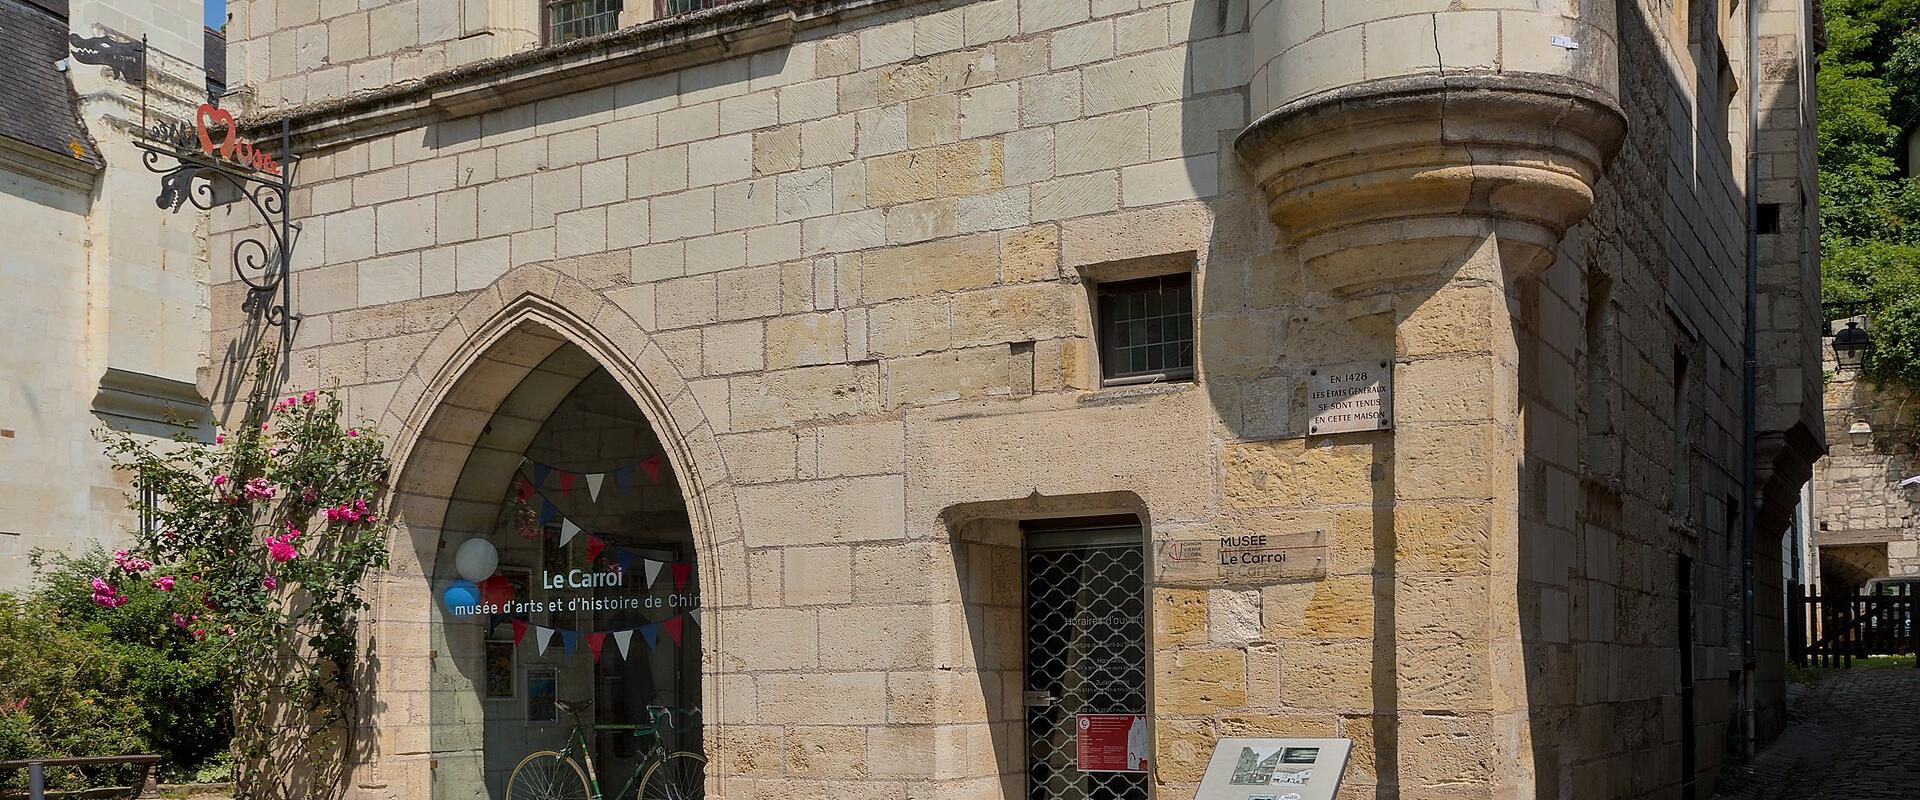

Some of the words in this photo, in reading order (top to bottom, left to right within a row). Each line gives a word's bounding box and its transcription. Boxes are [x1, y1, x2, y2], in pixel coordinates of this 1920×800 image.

[1330, 375, 1341, 383] EN
[1345, 372, 1368, 382] 1428
[1312, 391, 1325, 399] LES
[1318, 403, 1328, 411] SE
[1330, 401, 1352, 410] SONT
[1355, 399, 1381, 408] TENUS
[1315, 416, 1325, 424] EN
[1327, 413, 1352, 423] CETTE
[1354, 411, 1385, 420] MAISON
[1220, 533, 1267, 547] MUSÉE
[1221, 553, 1238, 565] Le
[1241, 551, 1286, 565] Carroi
[543, 570, 564, 590] Le
[568, 567, 623, 588] Carroi
[455, 601, 499, 616] musée
[503, 600, 543, 614] d'arts
[548, 598, 563, 612] et
[568, 596, 639, 611] d'histoire
[644, 595, 662, 609] de
